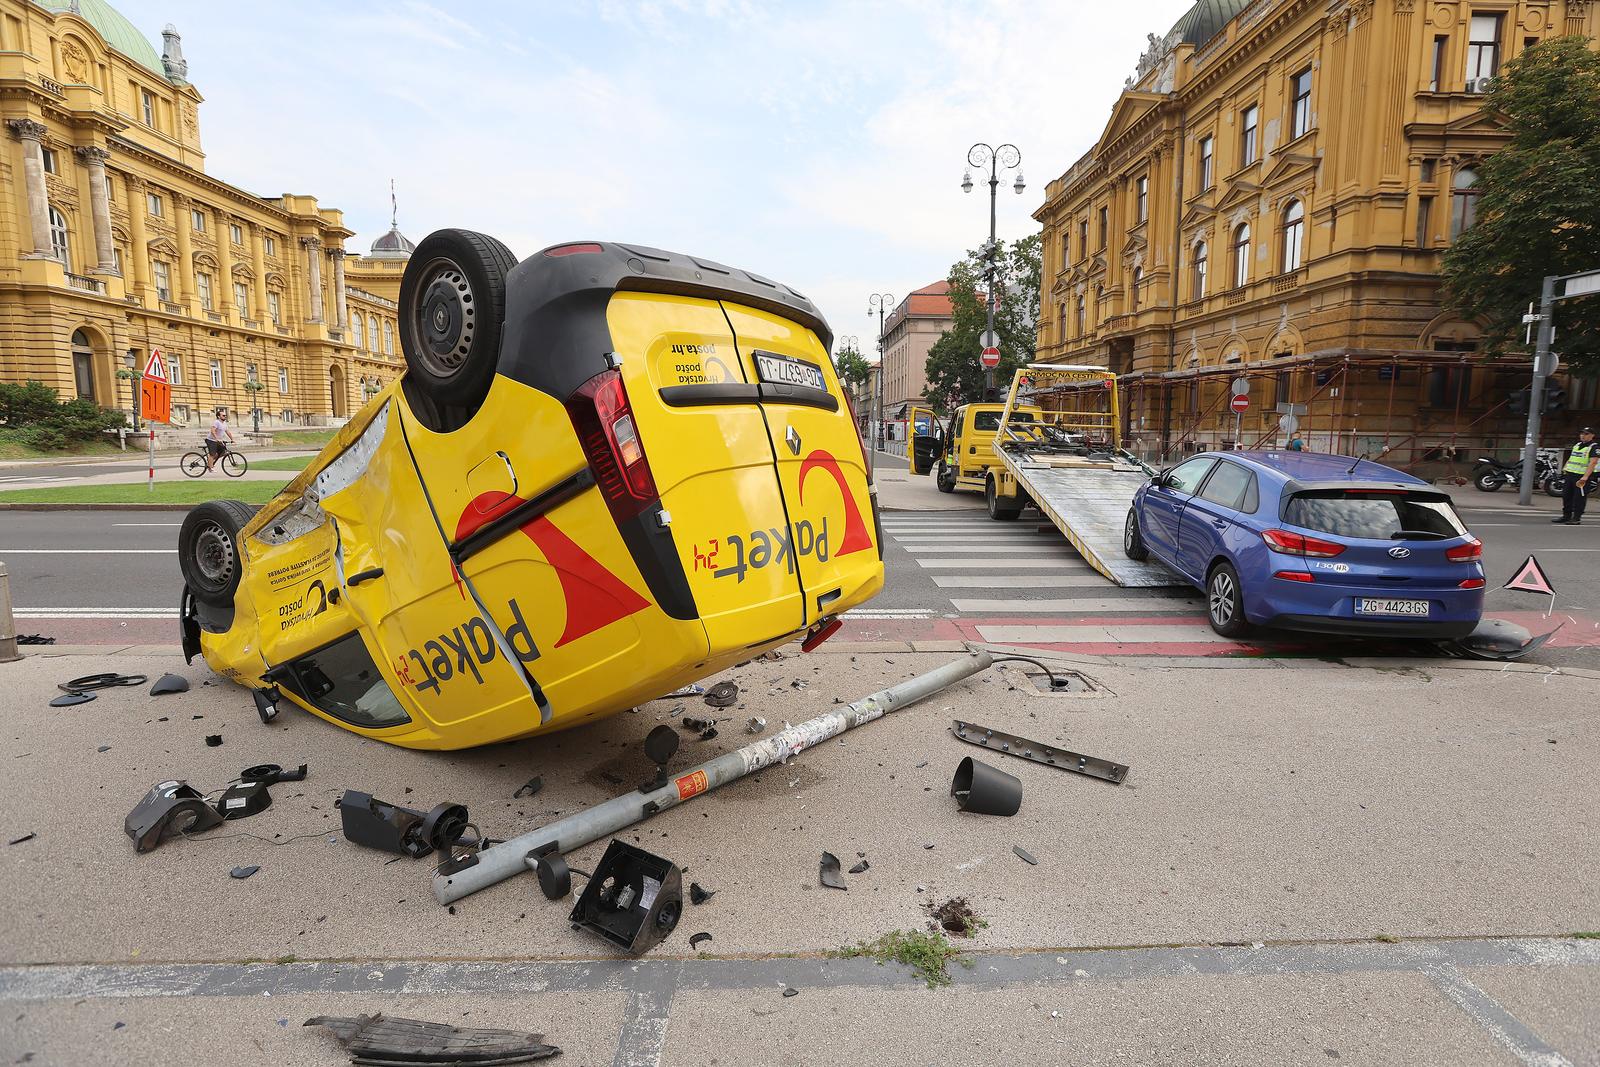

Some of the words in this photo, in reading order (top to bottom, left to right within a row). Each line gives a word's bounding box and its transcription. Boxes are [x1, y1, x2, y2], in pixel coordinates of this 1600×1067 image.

[671, 343, 716, 356] posta.hr
[675, 362, 701, 374] pošta
[806, 367, 821, 387] ZG
[679, 375, 719, 384] Hrvatska
[693, 539, 719, 572] 24
[713, 516, 829, 585] Paket
[279, 596, 303, 617] pošta
[1363, 600, 1377, 612] ZG
[281, 608, 314, 630] Hrvatska
[408, 598, 542, 697] Paket
